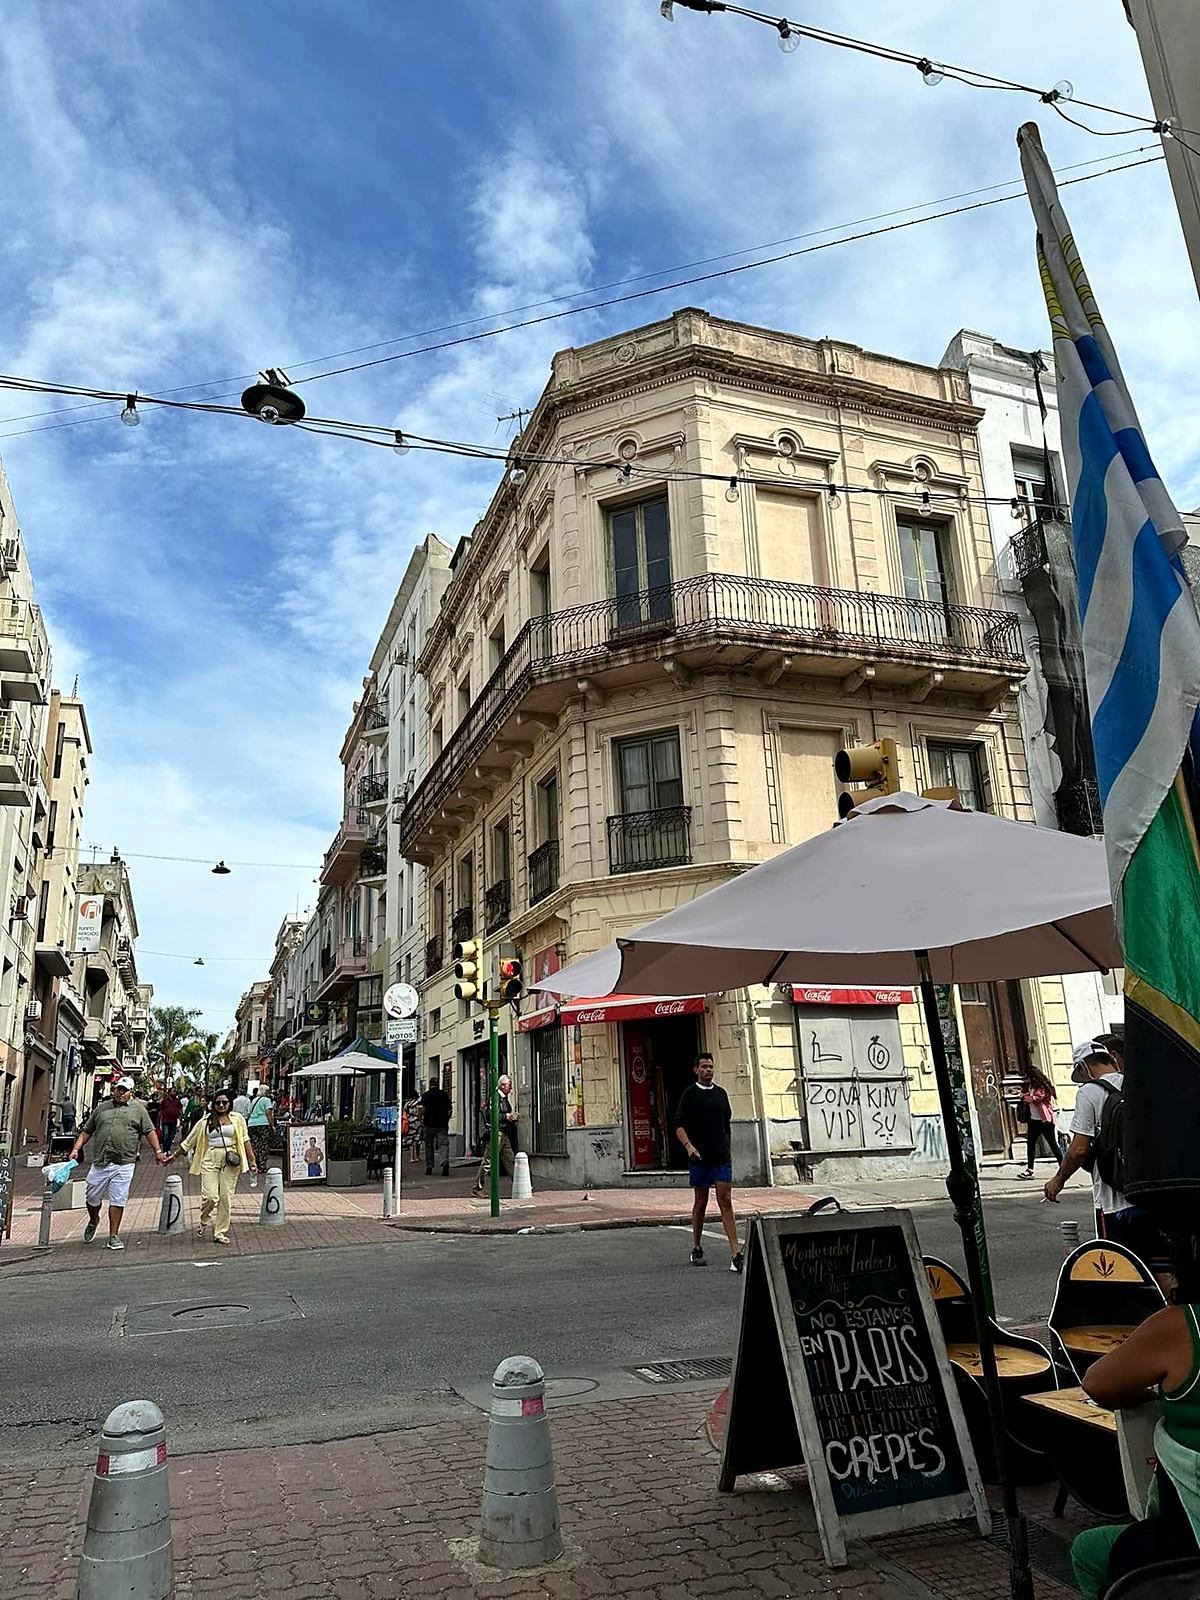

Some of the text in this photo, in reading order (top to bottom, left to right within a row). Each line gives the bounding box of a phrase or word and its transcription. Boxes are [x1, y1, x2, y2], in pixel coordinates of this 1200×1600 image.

[389, 1032, 413, 1040] MOTOS
[810, 1083, 897, 1109] ZONA KIN
[820, 1108, 857, 1140] VIP
[166, 1193, 181, 1231] D
[265, 1185, 280, 1214] 6
[810, 1306, 914, 1329] NO ESTAMOS
[800, 1325, 928, 1391] EN PARIS
[812, 1391, 851, 1418] PERO
[853, 1388, 872, 1412] TE
[818, 1406, 941, 1440] LOS MEJORES
[825, 1427, 946, 1484] CREPES
